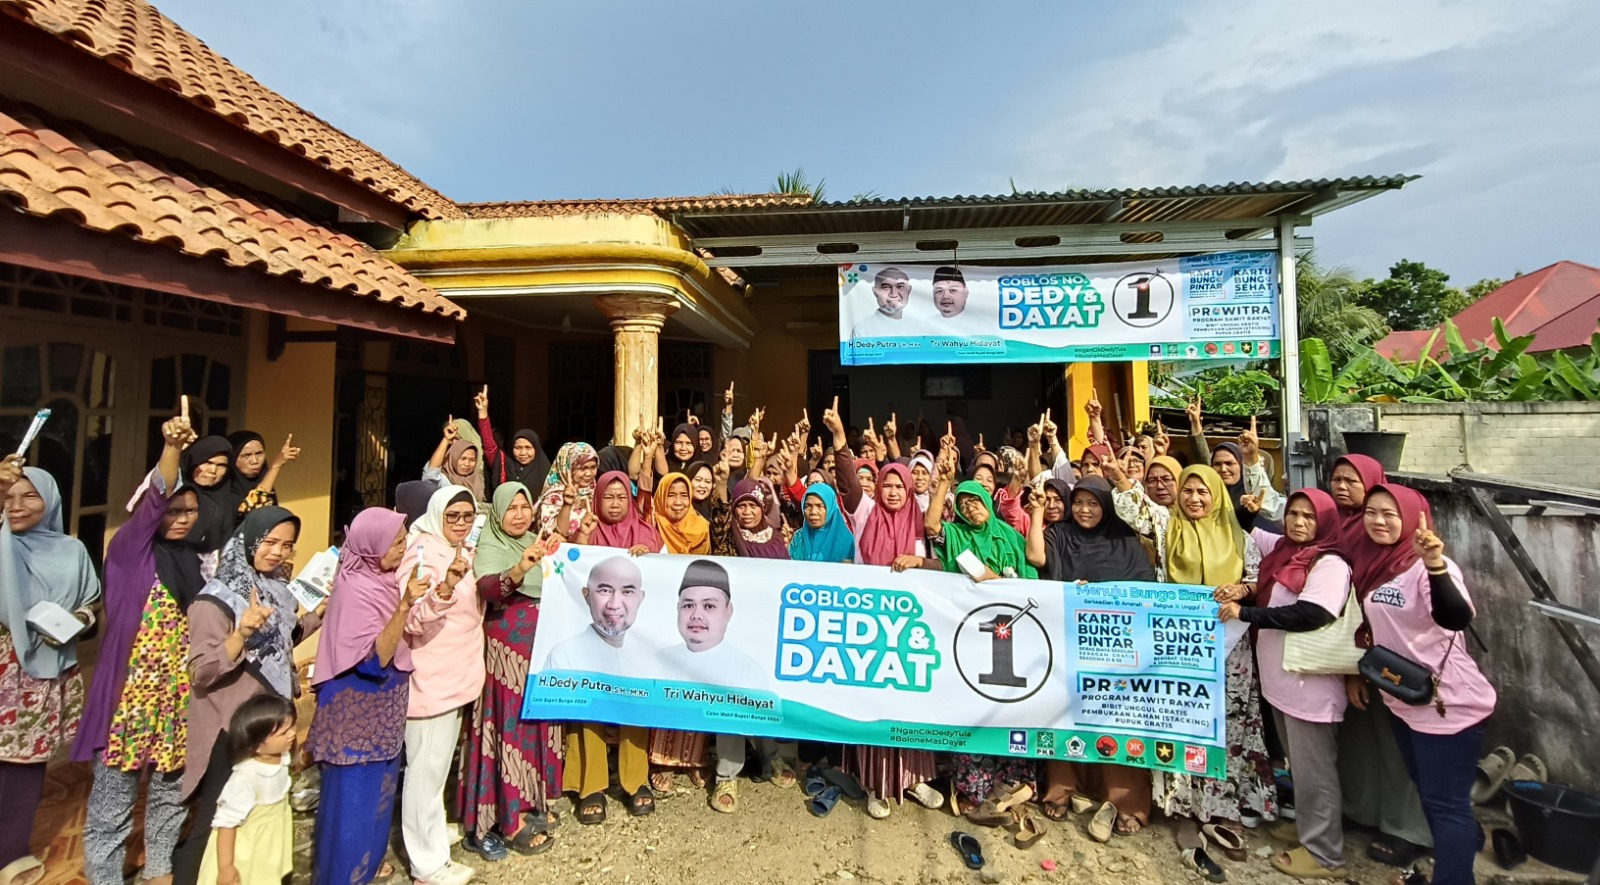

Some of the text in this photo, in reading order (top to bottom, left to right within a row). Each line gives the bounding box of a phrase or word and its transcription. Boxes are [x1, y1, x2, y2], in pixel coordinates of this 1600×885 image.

[1233, 268, 1272, 276] KARTU
[1001, 275, 1088, 287] COBLOS NO.
[1234, 283, 1273, 291] SEHAT
[1002, 285, 1098, 306] DEDY &
[1127, 277, 1158, 319] 1
[1002, 305, 1101, 327] DAYAT
[942, 340, 968, 349] Wahyu
[970, 340, 1000, 348] Hidayat
[1076, 585, 1127, 599] Menuju
[1129, 587, 1176, 602] Bungo
[786, 587, 918, 614] COBLOS NO.
[1373, 594, 1405, 607] DAYAT
[1078, 612, 1132, 625] KARTU
[1152, 617, 1217, 632] KARTU
[783, 607, 930, 650] DEDY &
[1078, 636, 1134, 649] PINTAR
[978, 613, 1027, 688] 1
[1153, 645, 1216, 658] SEHAT
[780, 643, 936, 687] DAYAT
[538, 675, 578, 690] H.Dedy
[664, 687, 775, 710] Tri Wahyu Hidayat
[1081, 694, 1211, 711] PROGRAM SAWIT RAKYAT
[1124, 704, 1157, 714] UNGGUL
[1158, 707, 1188, 717] GRATIS
[1081, 708, 1210, 727] PEMBUKAAN LAHAN (STACKING)
[1115, 717, 1173, 729] PUPUK GRATIS
[890, 726, 972, 738] #NganCikDedyTula
[890, 735, 966, 747] #BoloneMasDayat
[1009, 744, 1026, 752] PAN
[1126, 756, 1145, 765] PKS
